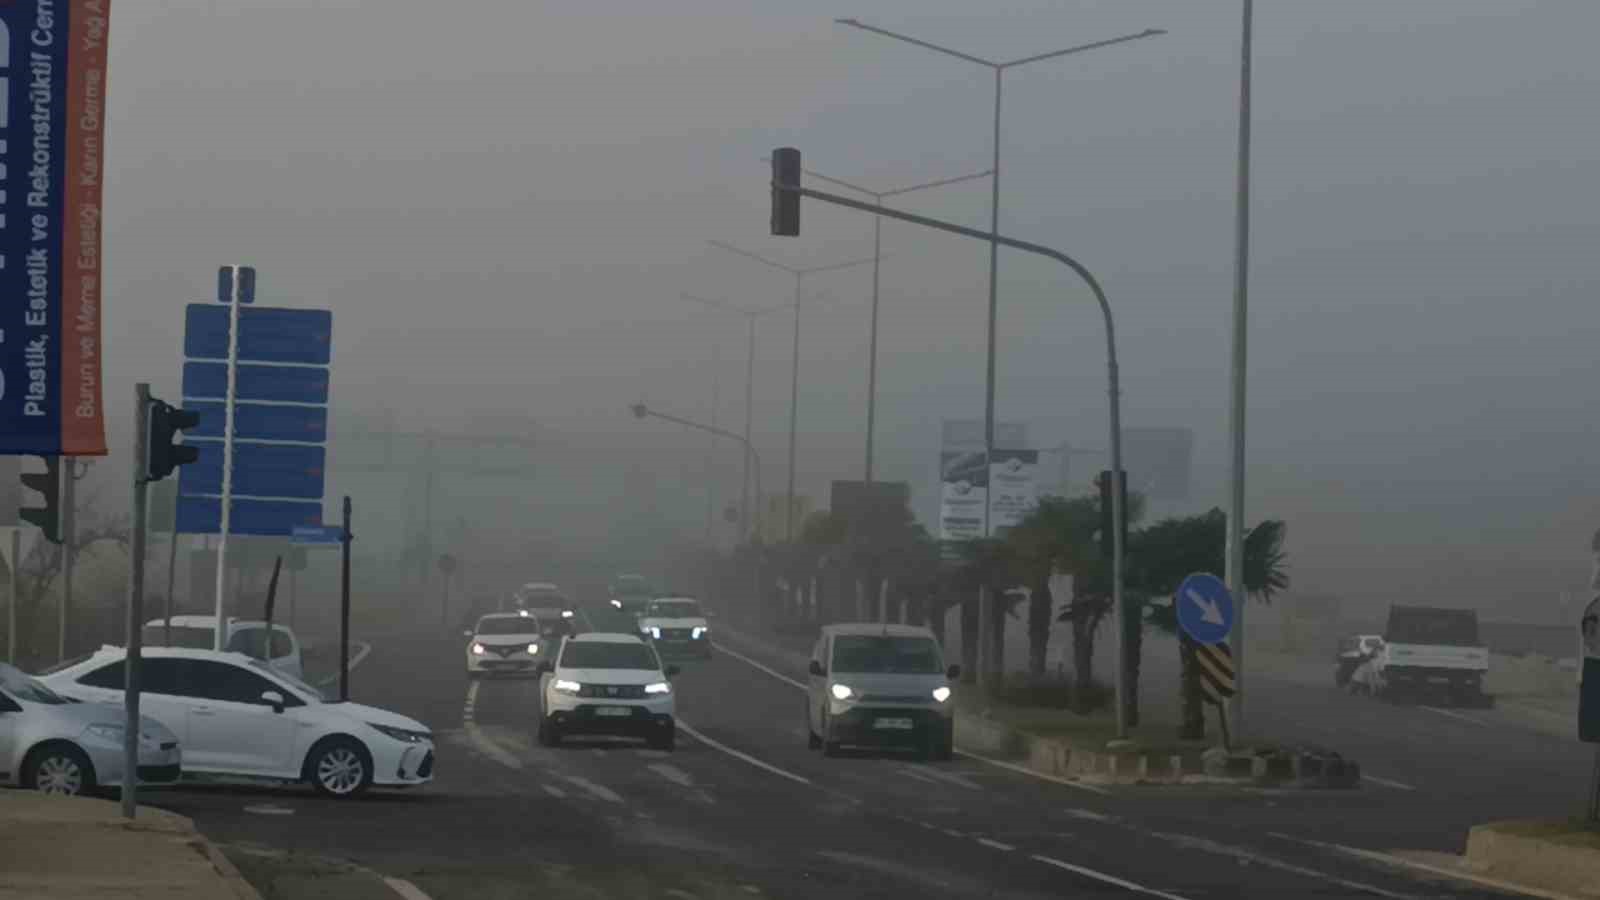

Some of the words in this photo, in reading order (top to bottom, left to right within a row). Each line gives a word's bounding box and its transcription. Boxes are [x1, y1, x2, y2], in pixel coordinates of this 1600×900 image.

[27, 53, 51, 206] Rekonstrüktif
[32, 214, 48, 241] ve
[25, 249, 48, 326] Estetik
[76, 275, 96, 332] Meme
[24, 334, 49, 416] Plastik,
[80, 336, 95, 359] ve
[76, 363, 95, 417] Burun
